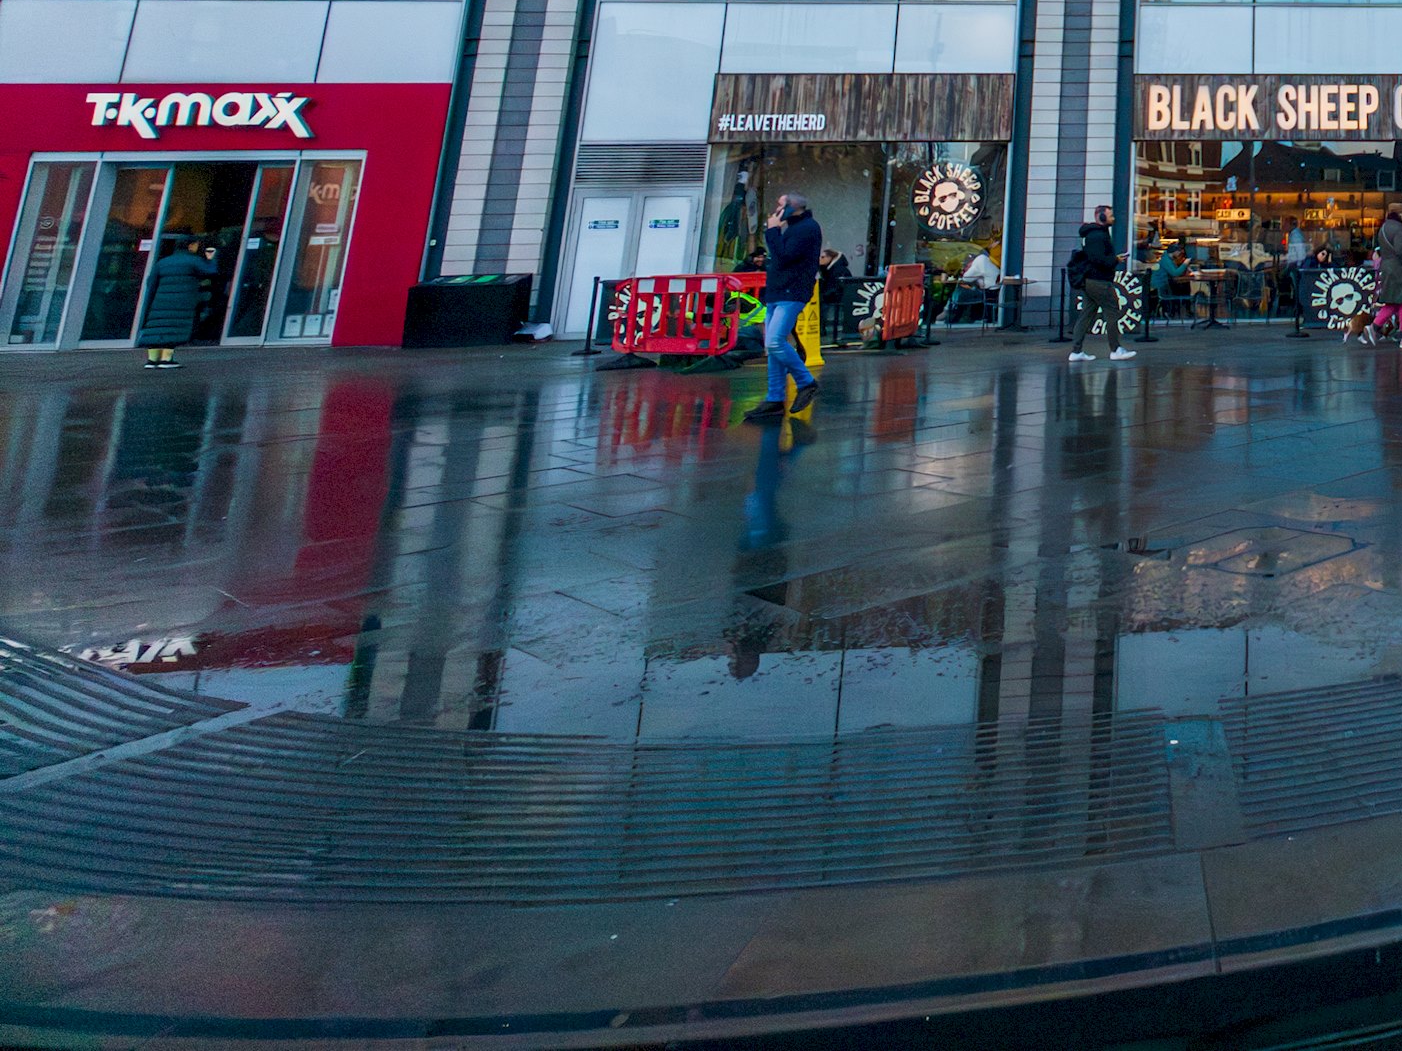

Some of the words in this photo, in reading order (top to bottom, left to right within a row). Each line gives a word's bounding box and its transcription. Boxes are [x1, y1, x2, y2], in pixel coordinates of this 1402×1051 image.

[1148, 84, 1260, 131] BLACK
[1276, 84, 1380, 131] SHEEP
[718, 113, 826, 132] #LEAVETHEHERD
[914, 164, 945, 204] BLACK
[946, 162, 981, 190] SHEEP
[927, 202, 979, 230] COFFEE
[1113, 270, 1143, 295] HEEP
